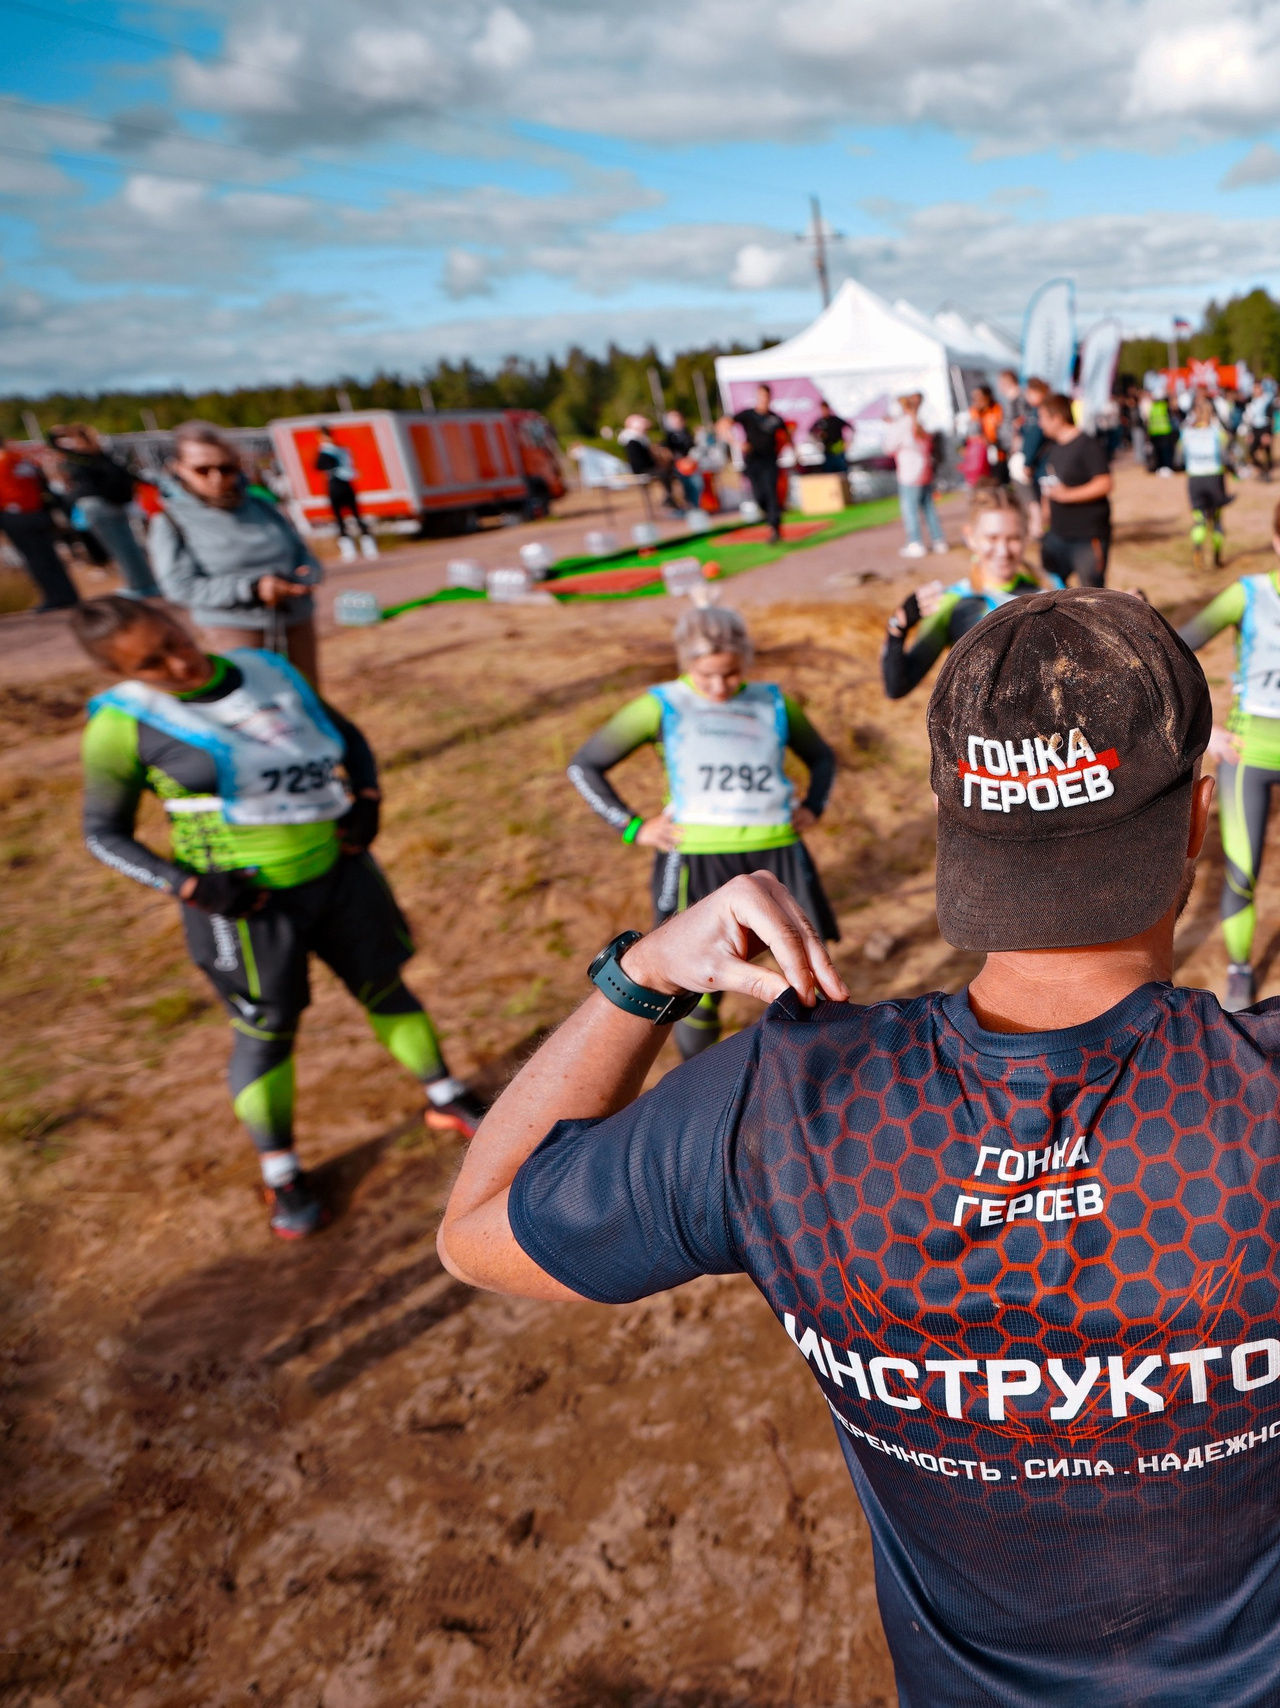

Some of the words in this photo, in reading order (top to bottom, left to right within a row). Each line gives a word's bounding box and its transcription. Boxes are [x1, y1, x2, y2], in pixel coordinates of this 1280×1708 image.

[967, 727, 1098, 777] ГОНКА
[698, 764, 773, 792] 7292
[963, 764, 1115, 813] ГЕРОЕВ
[974, 1136, 1090, 1182] ГОНКА
[953, 1183, 1104, 1227] ГЕРОЕВ
[1024, 1458, 1115, 1479] СИЛА
